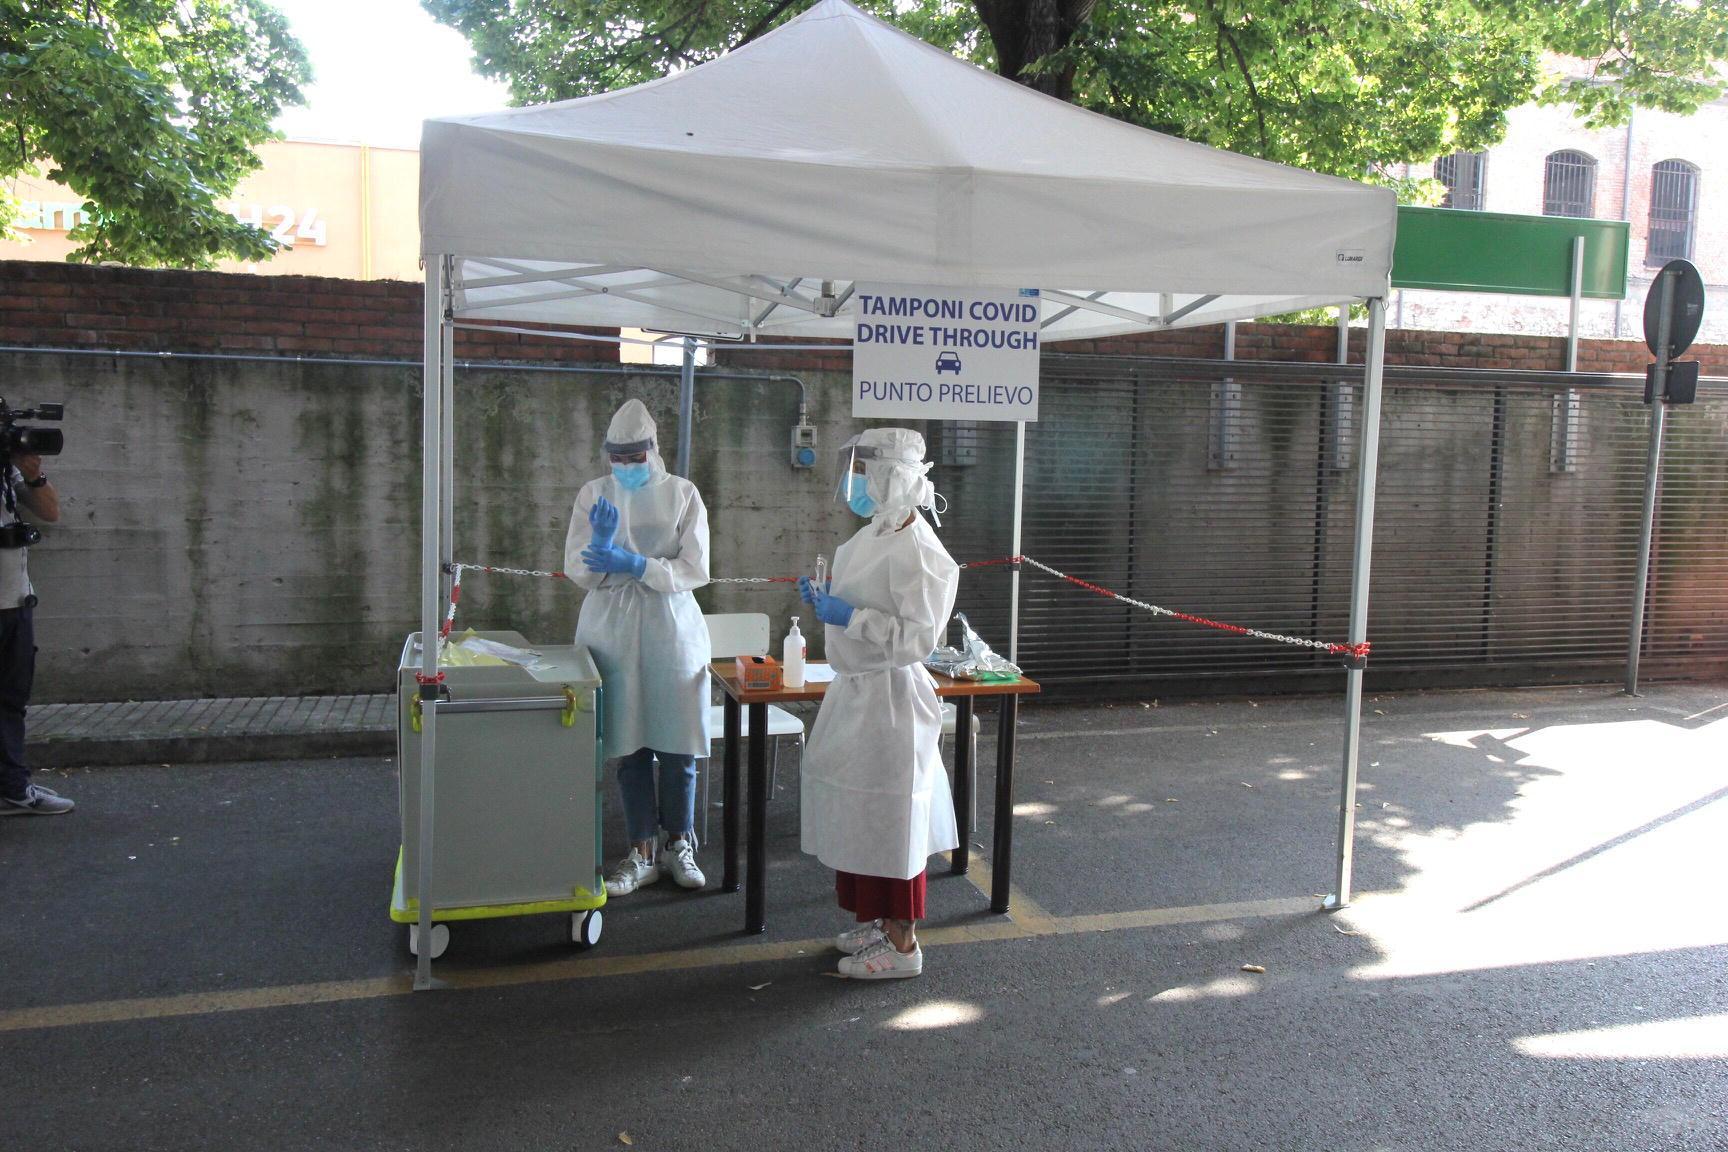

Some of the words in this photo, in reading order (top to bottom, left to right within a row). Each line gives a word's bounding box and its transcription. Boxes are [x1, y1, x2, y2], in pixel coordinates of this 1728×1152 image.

[858, 295, 963, 320] TAMPONI
[969, 301, 1037, 323] COVID
[857, 323, 925, 346] DRIVE
[928, 326, 1038, 350] THROUGH
[860, 381, 933, 402] PUNTO
[939, 383, 1034, 406] PRELIEVO
